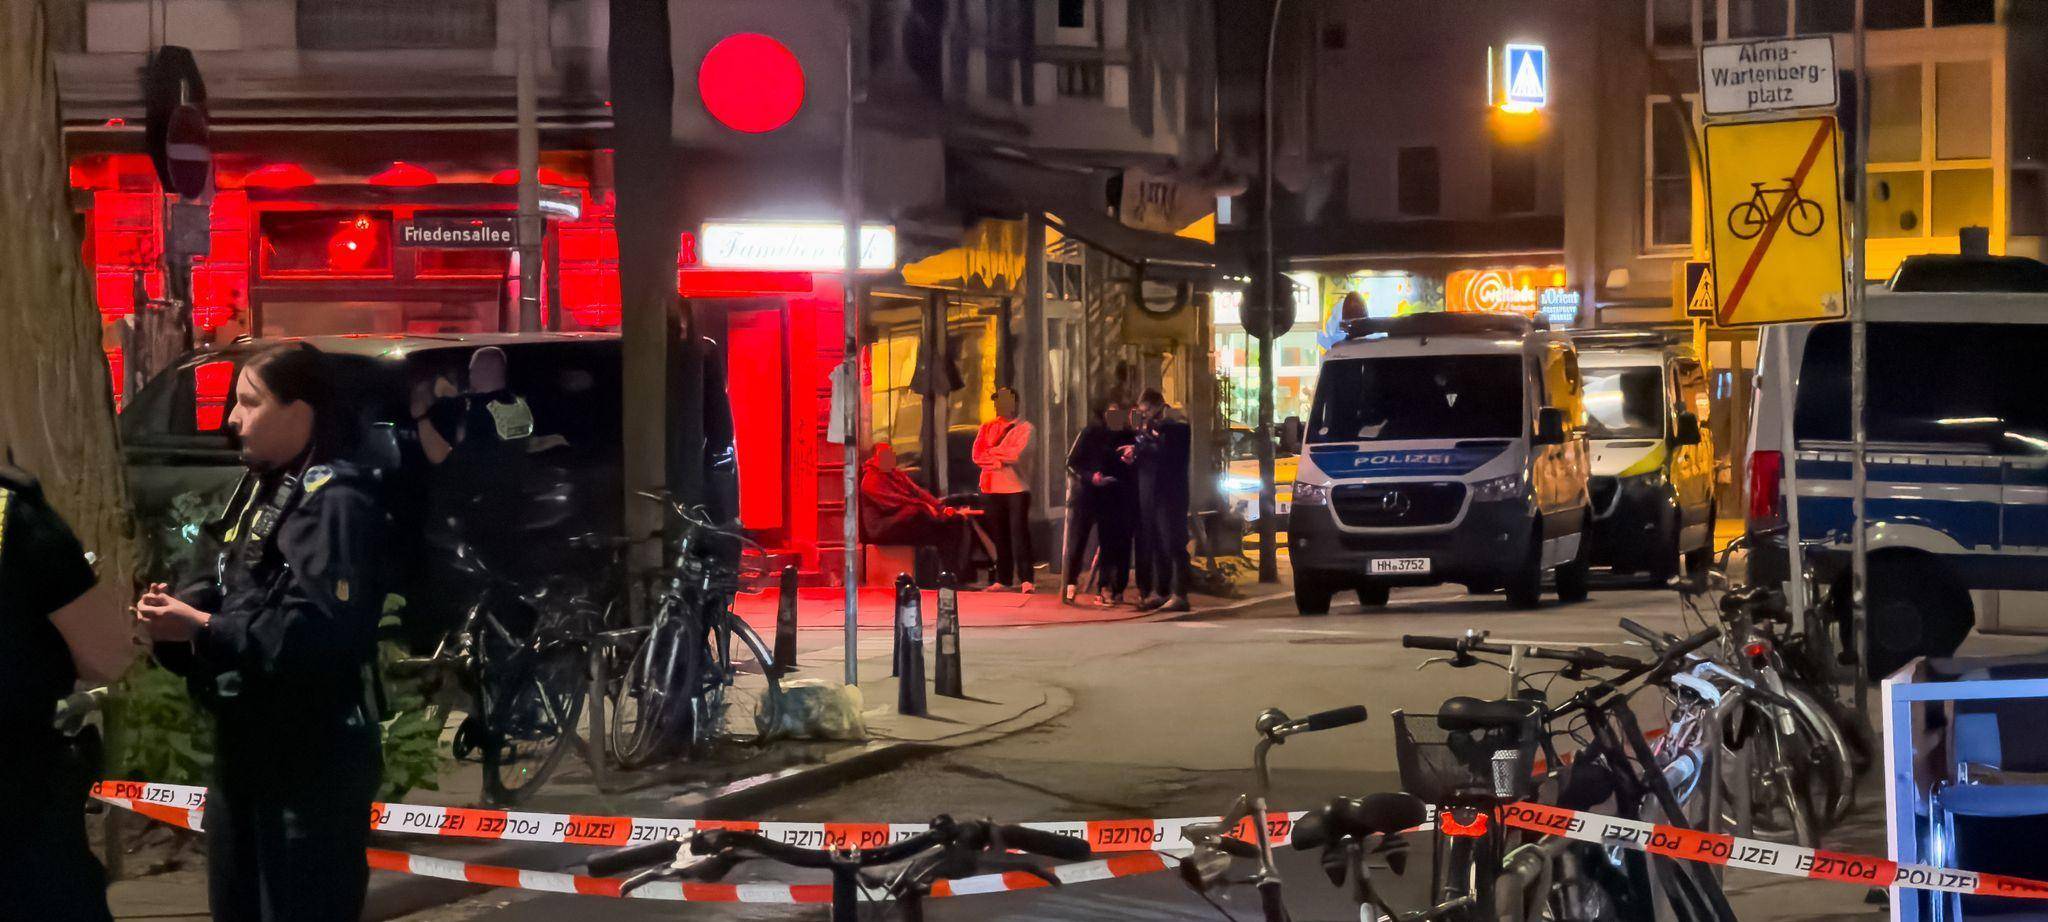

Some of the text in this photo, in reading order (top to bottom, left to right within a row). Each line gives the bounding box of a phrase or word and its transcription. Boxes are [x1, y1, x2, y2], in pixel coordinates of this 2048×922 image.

[1739, 43, 1797, 62] Alma-
[1711, 64, 1826, 87] Wartenberg-
[1748, 87, 1794, 108] platz
[405, 226, 511, 241] Friedensallee
[1354, 455, 1451, 467] POLIZEI
[1377, 560, 1425, 571] HH 3752
[114, 783, 175, 803] POLIZEI
[402, 812, 465, 830] POLIZEI
[476, 816, 540, 835] POLIZEI
[552, 821, 615, 839] POLIZEI
[627, 825, 681, 840] OLIZEI
[1098, 827, 1164, 845] POLIZEI
[1504, 806, 1586, 833] POLIZEI
[1601, 823, 1681, 850] POLIZEI
[1698, 840, 1779, 866] POLIZEI
[1796, 854, 1877, 880] POLIZEI
[1895, 868, 1978, 889] POLIZEI
